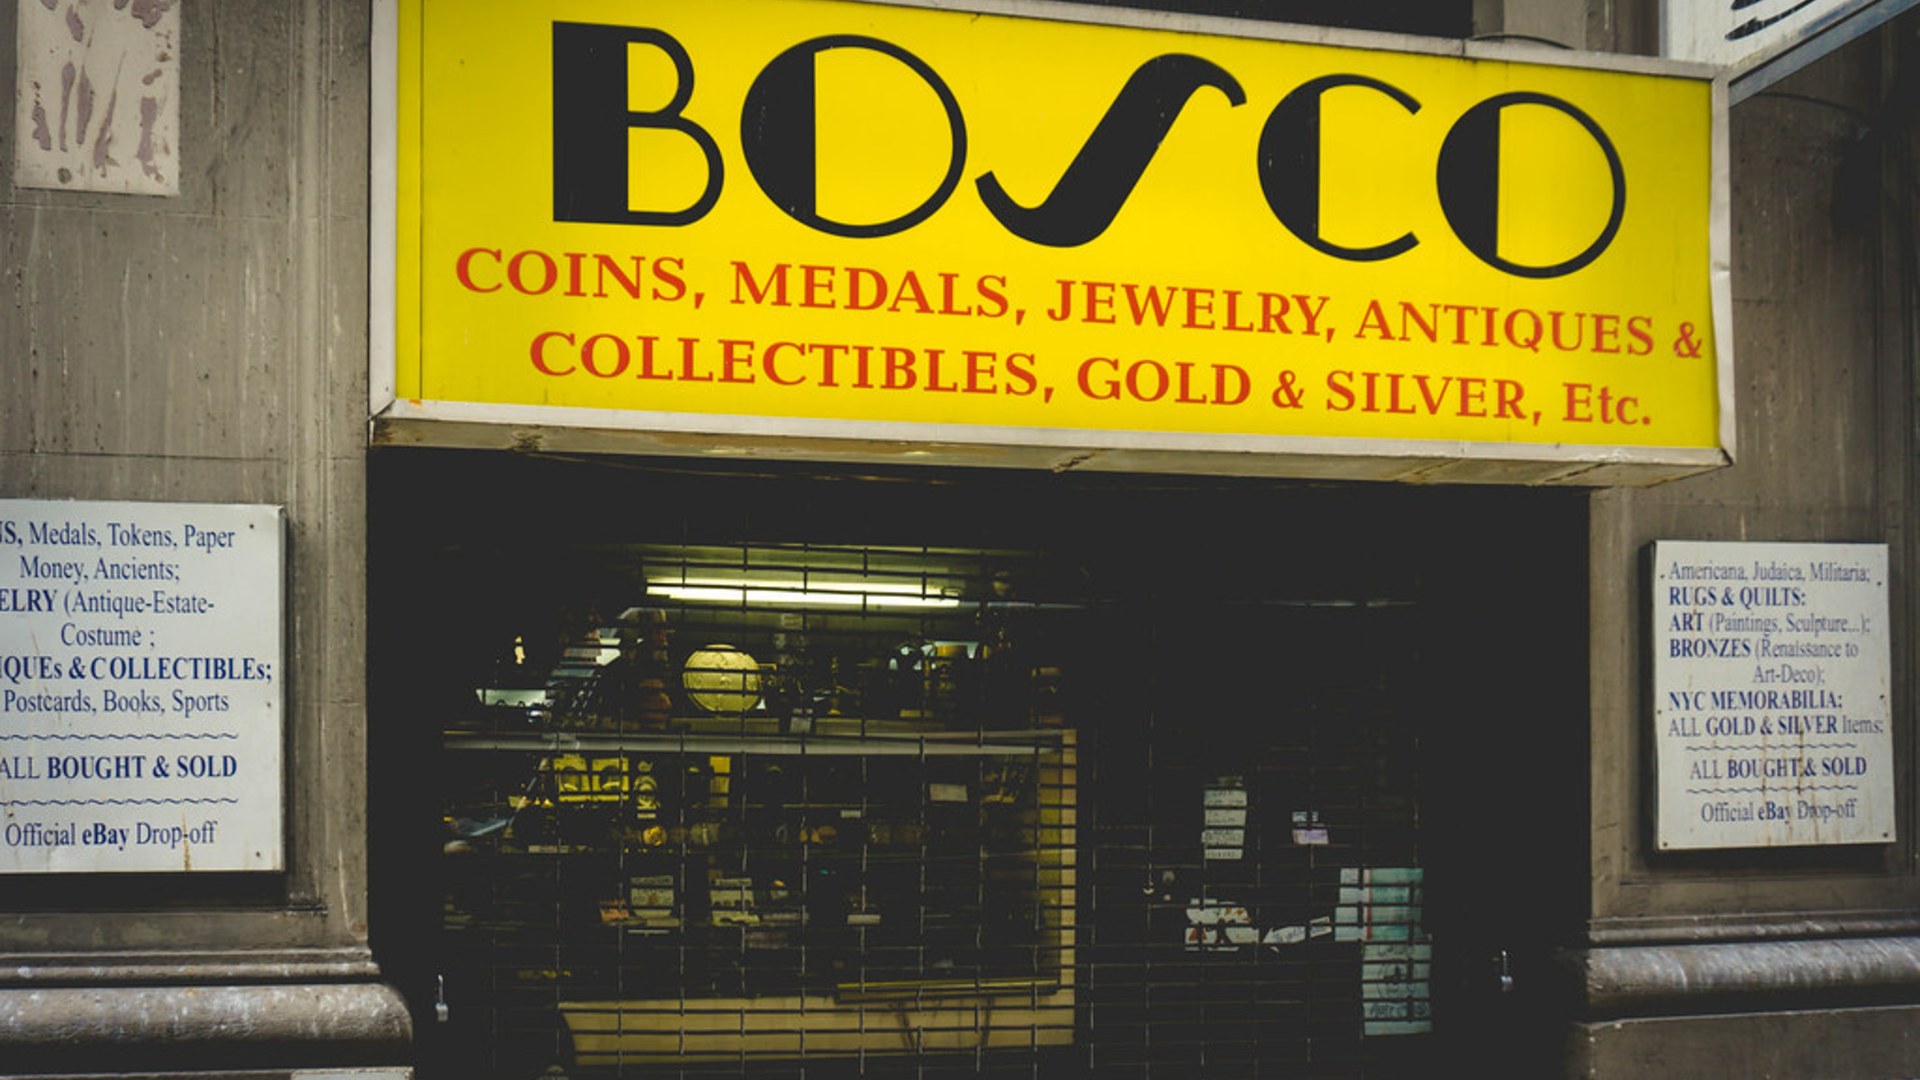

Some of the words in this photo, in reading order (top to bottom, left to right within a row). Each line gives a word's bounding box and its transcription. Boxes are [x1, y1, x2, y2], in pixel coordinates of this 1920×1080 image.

[552, 20, 1627, 280] BOSCO
[455, 247, 706, 308] COINS,
[730, 261, 1027, 325] MEDALS,
[1048, 279, 1334, 343] JEWELRY,
[1354, 299, 1654, 357] ANTIQUES
[1674, 321, 1703, 359] &
[530, 331, 1054, 403] COLLECTIBLES,
[1077, 358, 1252, 406] GOLD
[1272, 370, 1305, 409] &
[1326, 371, 1542, 427] SILVER,
[1563, 381, 1653, 426] Etc.
[29, 521, 102, 549] Medals,
[108, 522, 177, 551] Tokens,
[184, 524, 236, 554] Paper
[20, 554, 89, 585] Money,
[94, 556, 181, 583] Ancients;
[63, 590, 215, 619] (Antique-Estate-
[1668, 587, 1717, 606] RUGS
[1721, 587, 1735, 606] &
[60, 622, 143, 647] Costume
[1668, 611, 1705, 632] ART
[1669, 638, 1752, 659] BRONZES
[1845, 640, 1859, 658] to
[68, 656, 87, 680] &
[90, 656, 272, 684] COLLECTIBLEs;
[4, 689, 97, 715] Postcards,
[103, 689, 166, 715] Books,
[171, 689, 230, 718] Sports
[1668, 691, 1707, 711] NYC
[1668, 717, 1702, 737] ALL
[1705, 716, 1756, 736] GOLD
[1760, 716, 1773, 735] &
[1778, 715, 1838, 735] SILVER
[0, 756, 40, 780] ALL
[47, 755, 147, 780] BOUGHT
[152, 755, 170, 779] &
[176, 755, 238, 779] SOLD
[1690, 760, 1723, 780] ALL
[1727, 758, 1800, 779] BOUGHT
[1804, 757, 1817, 777] &
[1822, 757, 1867, 776] SOLD
[1701, 801, 1755, 823] Official
[1757, 802, 1792, 826] eBay
[5, 822, 76, 847] Official
[81, 823, 130, 852] eBay
[136, 820, 219, 849] Drop-off
